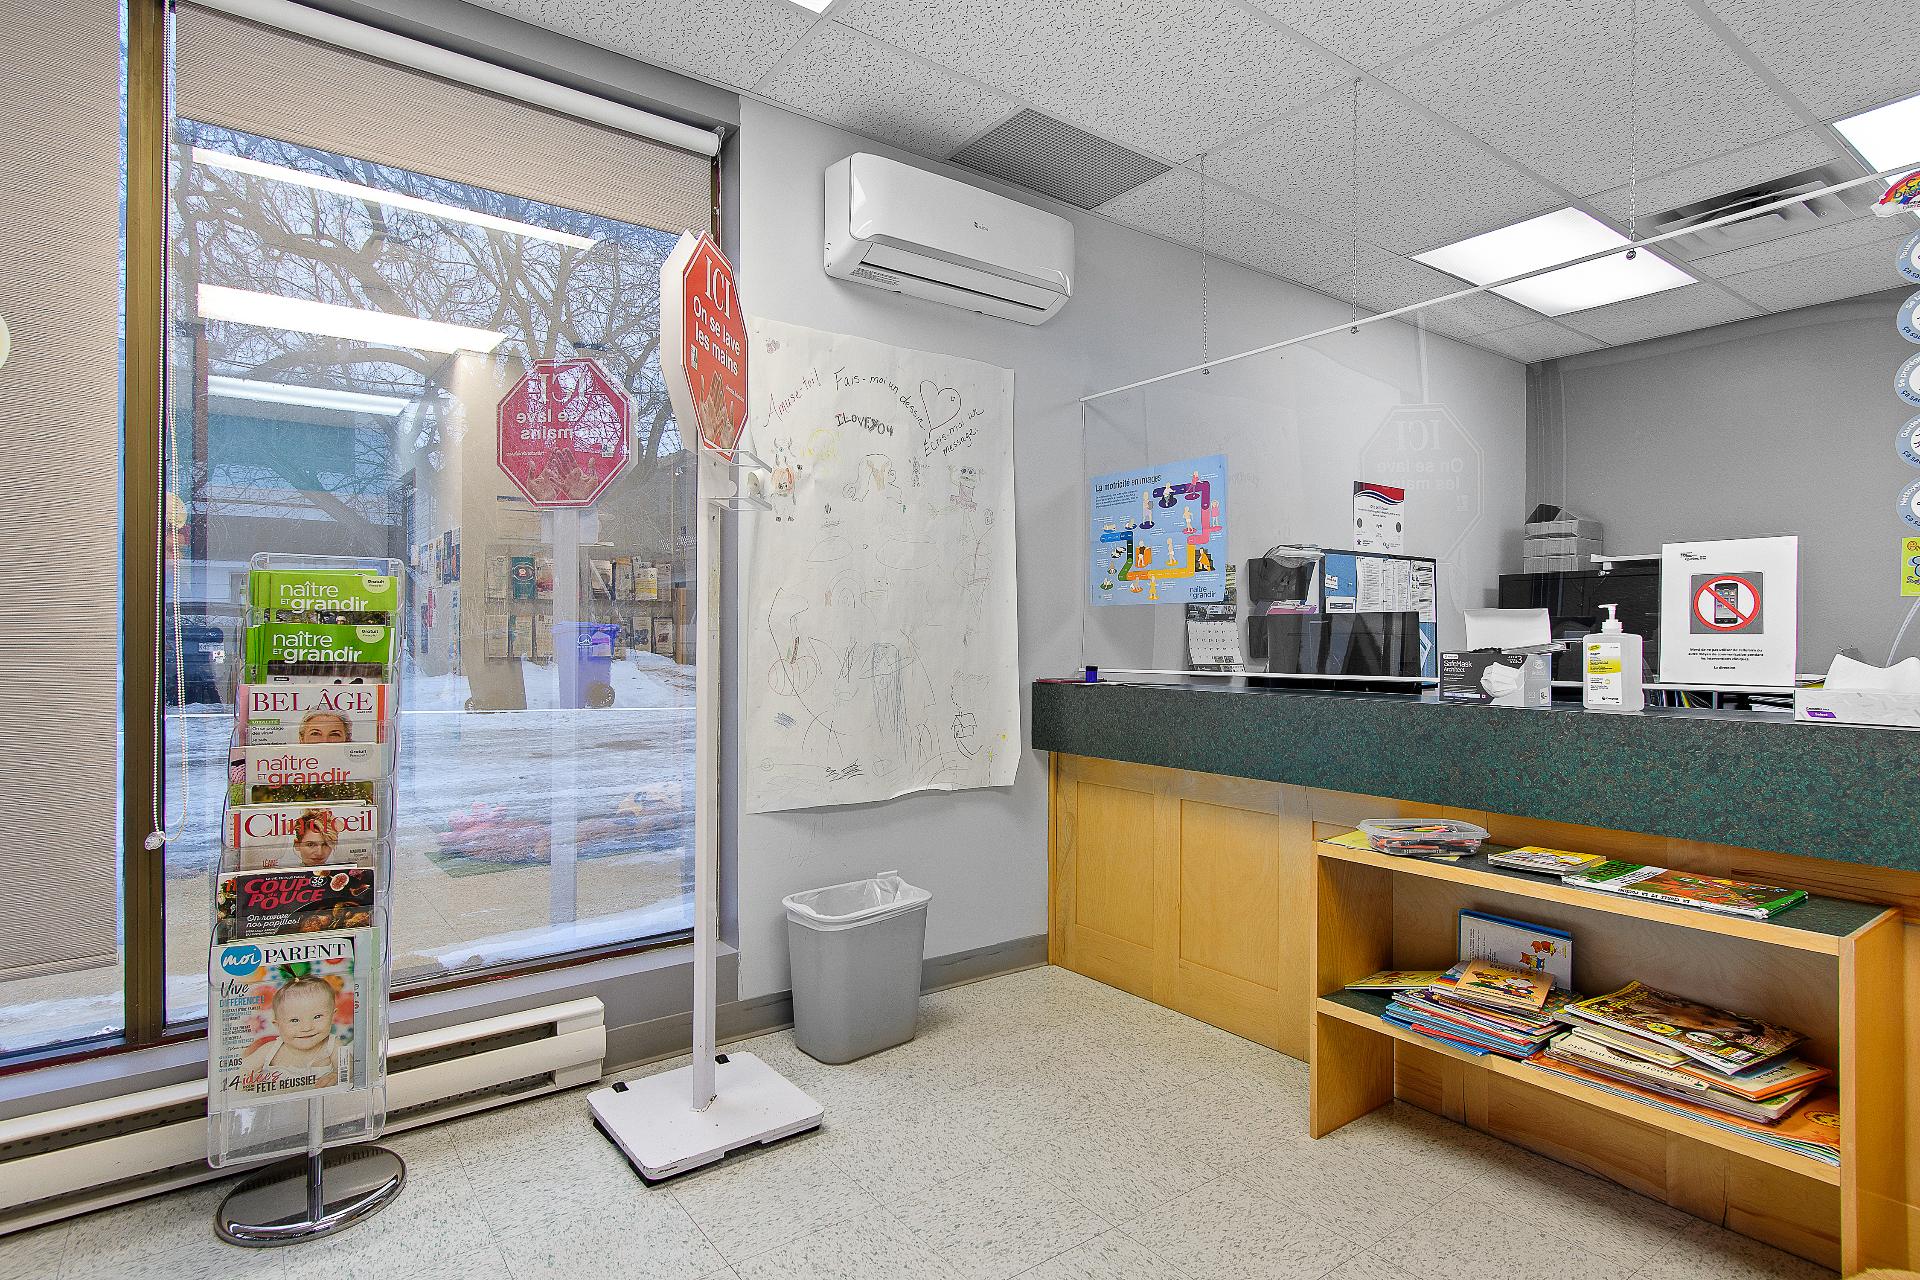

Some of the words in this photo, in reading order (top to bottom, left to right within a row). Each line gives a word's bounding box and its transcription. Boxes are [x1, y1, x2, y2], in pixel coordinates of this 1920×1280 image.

[705, 254, 731, 320] ICI
[693, 296, 708, 326] On
[710, 316, 720, 337] se
[723, 323, 740, 356] lave
[695, 321, 710, 352] les
[712, 341, 738, 377] mains
[280, 581, 339, 597] naître
[290, 597, 368, 614] grandir
[273, 631, 333, 647] naître
[283, 647, 362, 664] grandir
[252, 692, 310, 712] BEL
[316, 688, 373, 711] ÂGE
[257, 755, 319, 771] naître
[268, 768, 350, 788] grandir
[244, 813, 304, 838] Clin
[244, 878, 310, 894] COUP
[248, 888, 326, 910] POUCE
[263, 918, 300, 929] papilles!
[222, 952, 260, 968] moi
[264, 943, 346, 963] PARENT
[220, 979, 249, 998] Vive
[242, 1070, 283, 1085] idées
[280, 1075, 316, 1089] RÉUSSIE!
